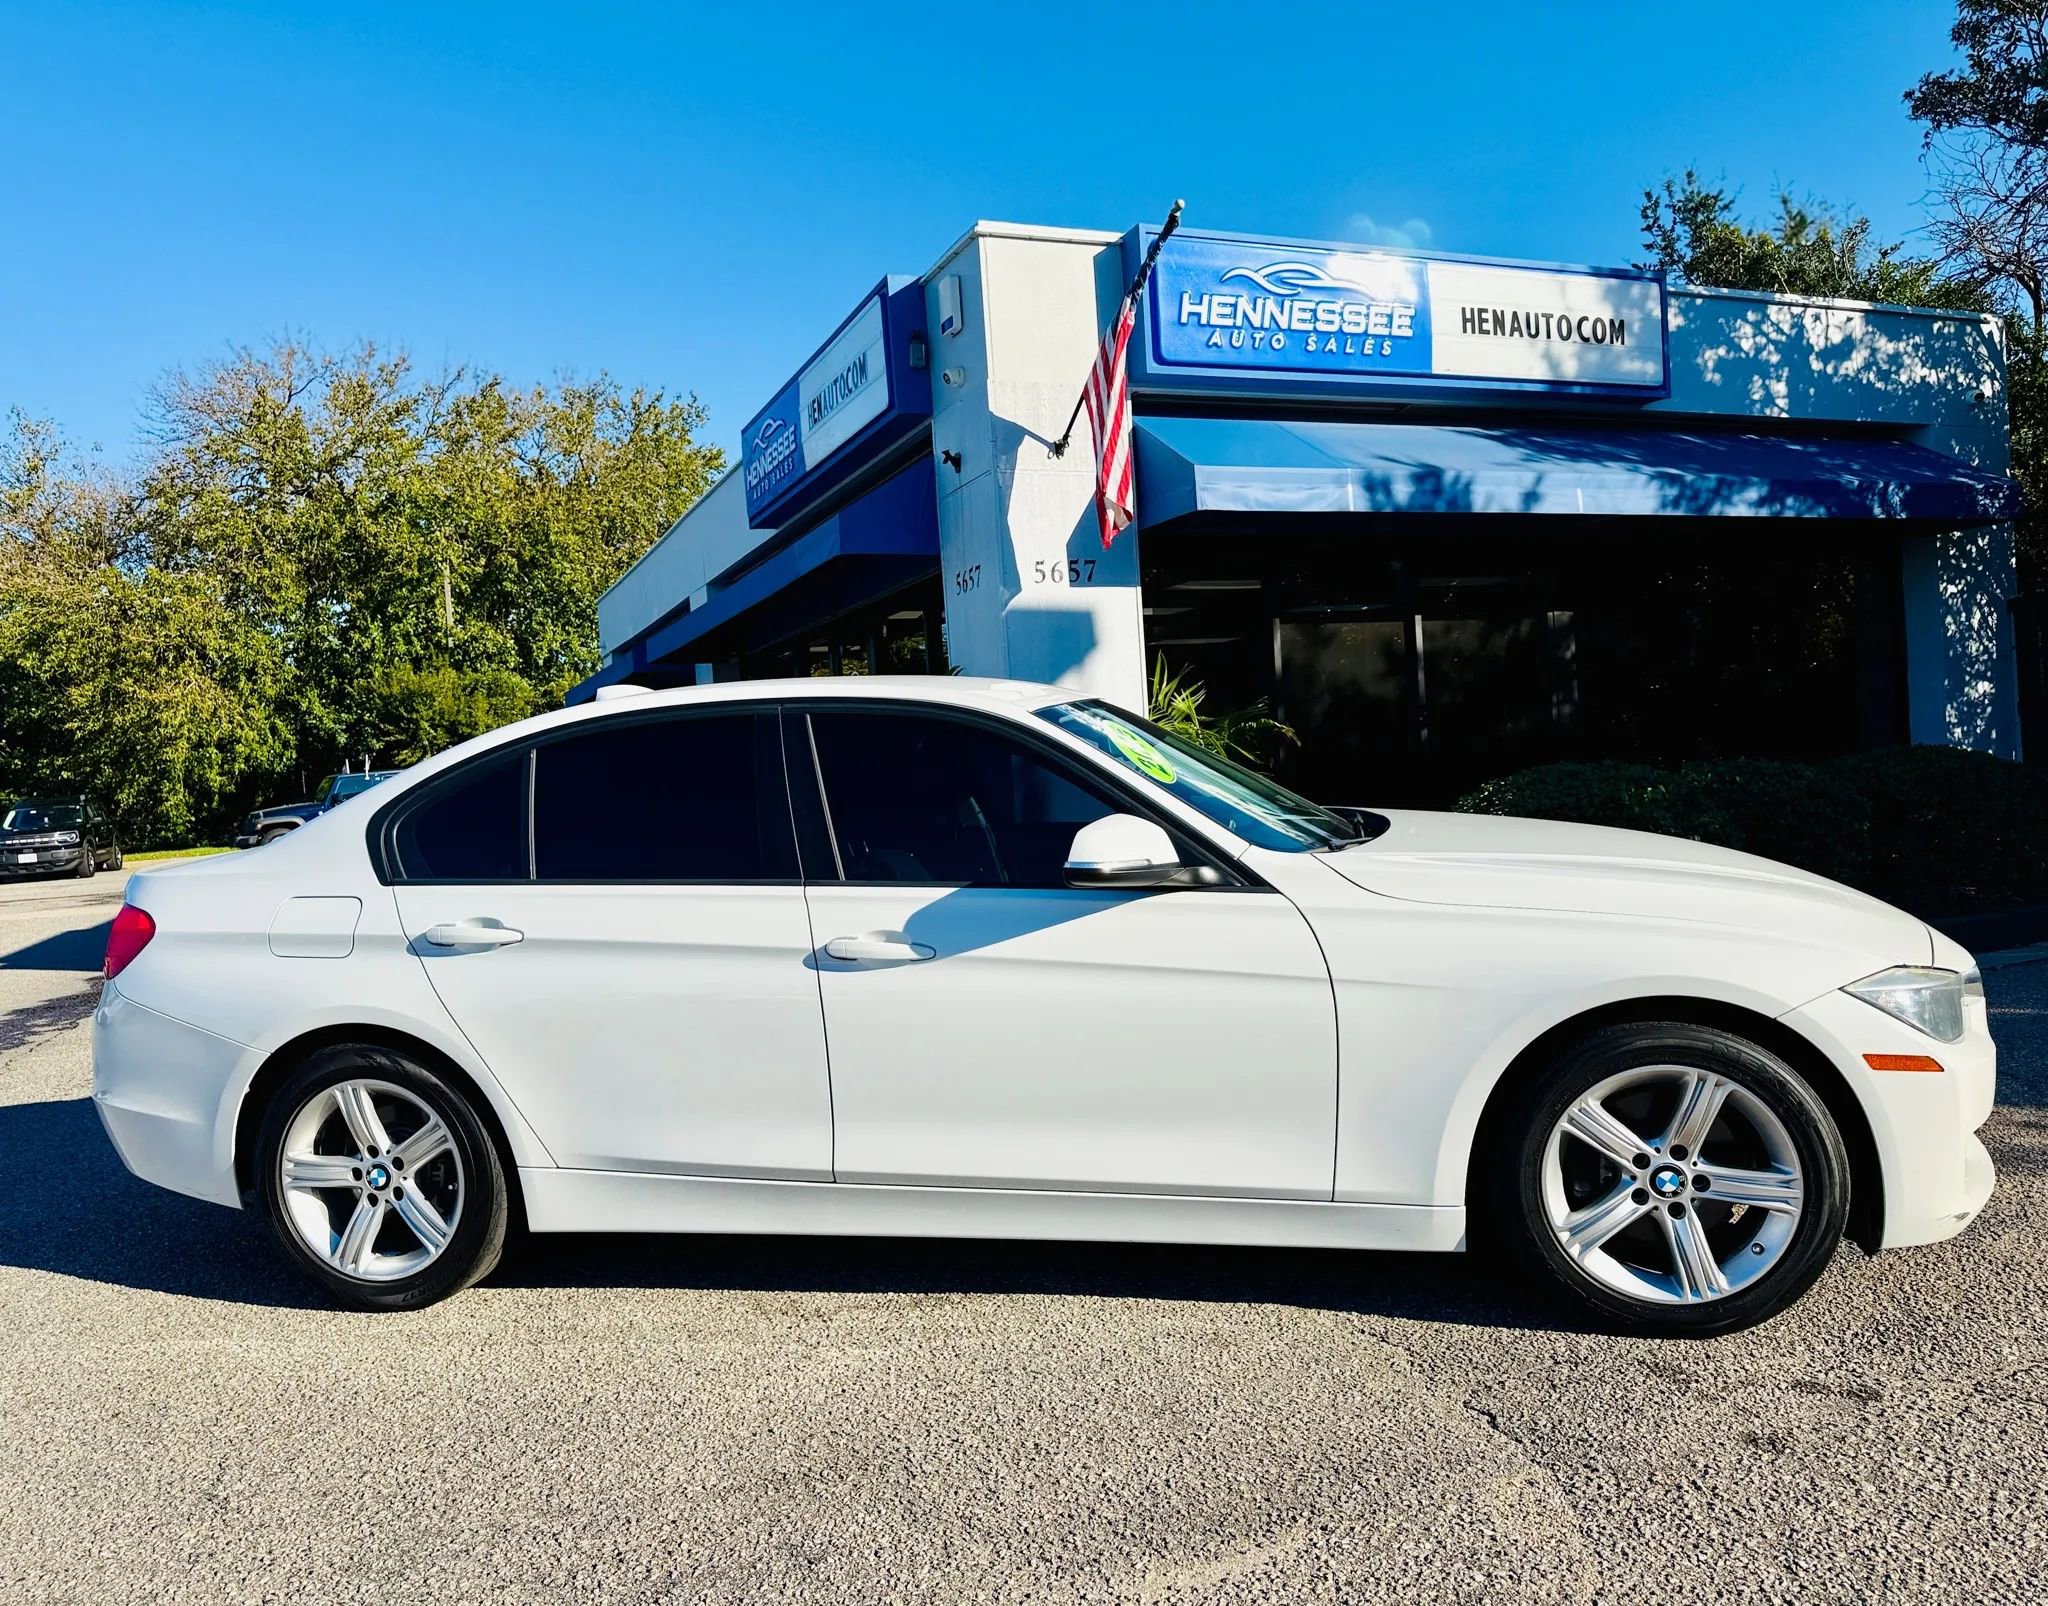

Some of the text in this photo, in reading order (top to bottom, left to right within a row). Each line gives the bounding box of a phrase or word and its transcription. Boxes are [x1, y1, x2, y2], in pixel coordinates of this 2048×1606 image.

[1180, 291, 1415, 337] HENNESSEE
[1208, 328, 1393, 356] AUTO SALES
[746, 424, 797, 491] HENNESSEE
[753, 457, 793, 499] AUTO SALES
[955, 564, 981, 596] 5657
[1034, 559, 1097, 584] 5657
